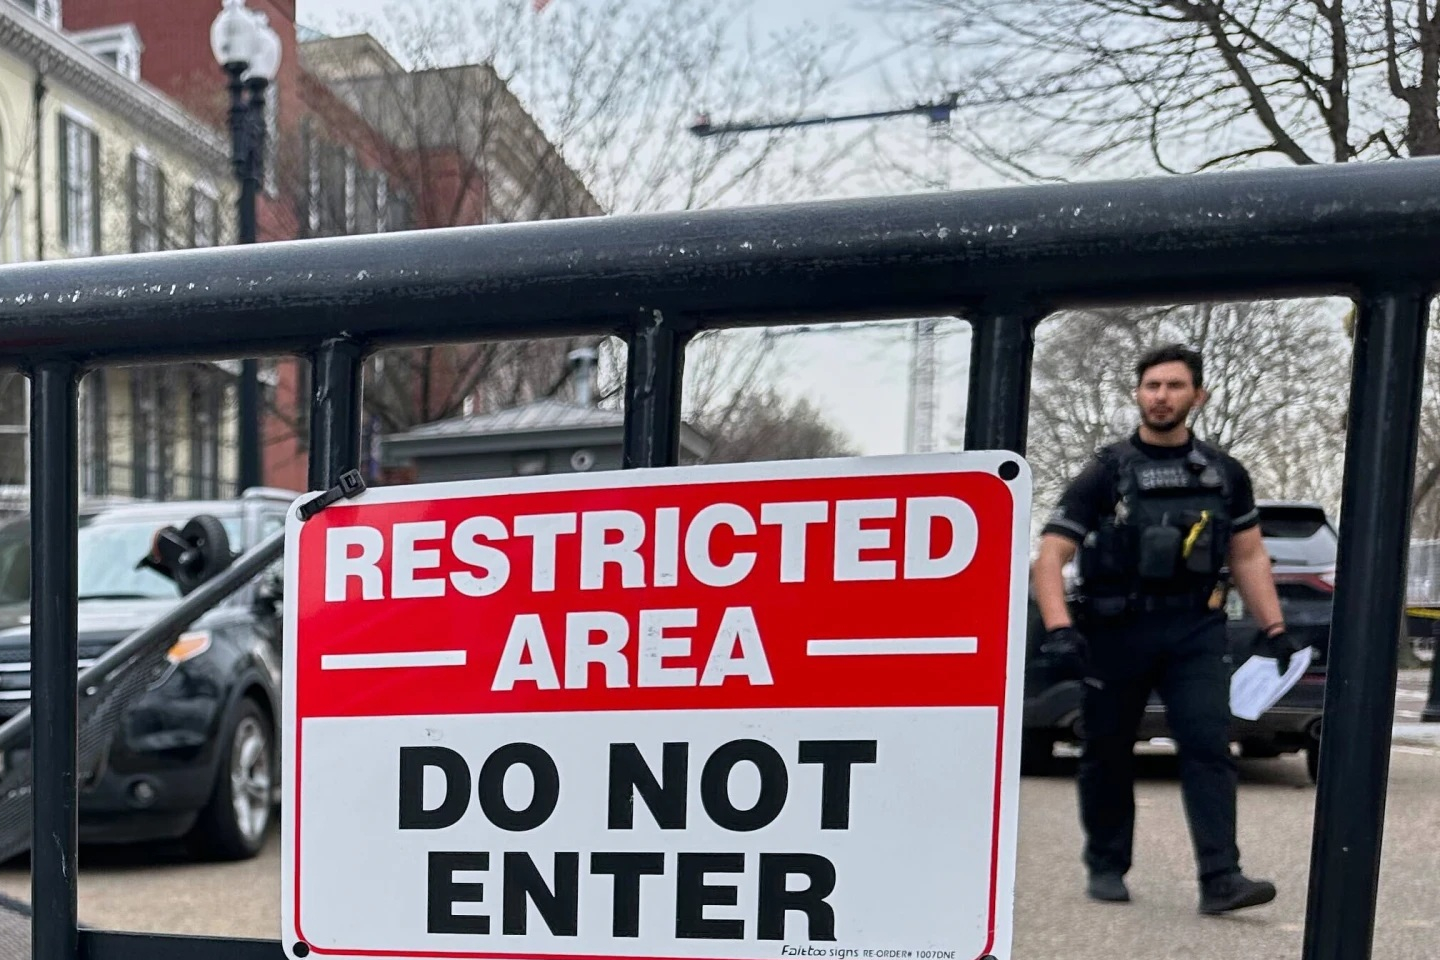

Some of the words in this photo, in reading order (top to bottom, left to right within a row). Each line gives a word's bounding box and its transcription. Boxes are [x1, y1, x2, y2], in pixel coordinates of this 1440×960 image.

[324, 496, 979, 602] RESTRICTED
[491, 607, 774, 691] AREA
[398, 742, 560, 832] DO
[607, 739, 878, 831] NOT
[426, 851, 837, 942] ENTER
[829, 947, 859, 960] signs
[863, 949, 912, 959] RE-ORDER#
[916, 950, 956, 959] 1007DNE
